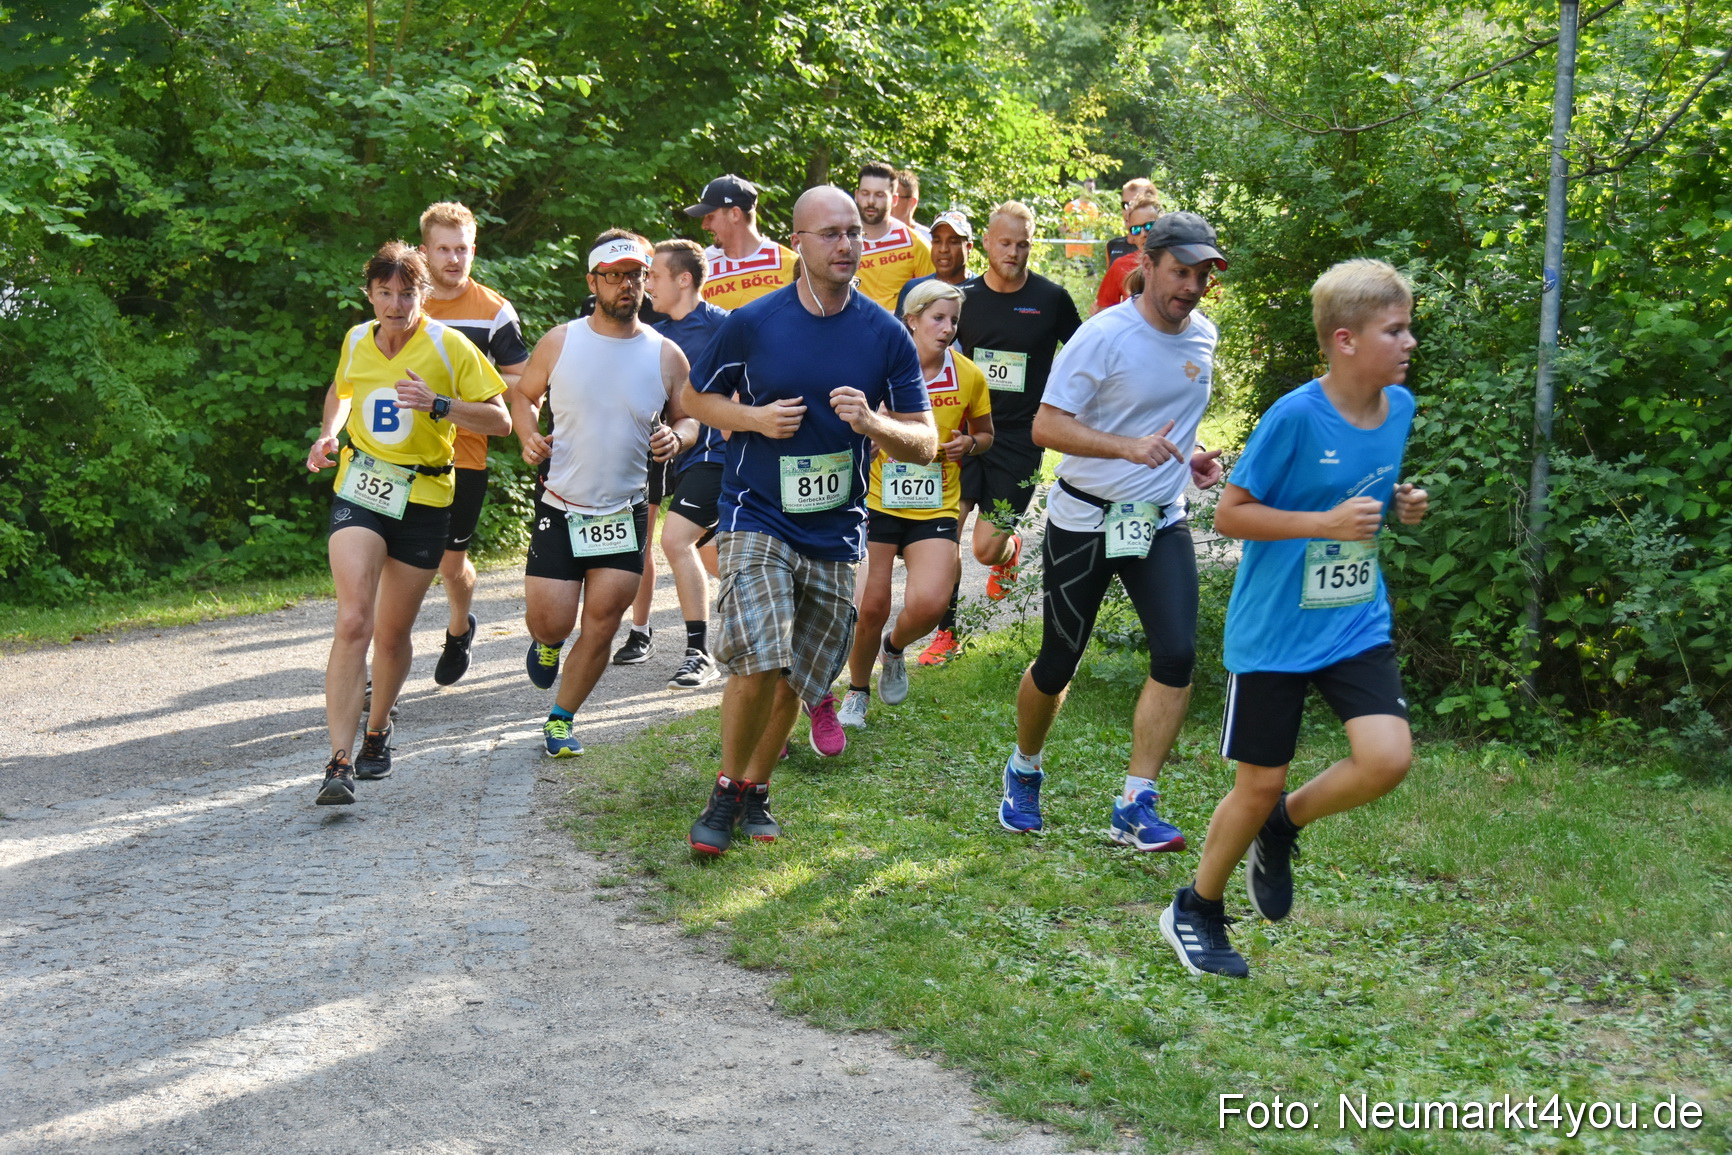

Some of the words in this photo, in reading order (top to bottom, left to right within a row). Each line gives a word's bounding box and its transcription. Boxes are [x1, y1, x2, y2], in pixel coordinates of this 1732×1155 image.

[858, 259, 875, 270] AX
[879, 252, 914, 265] BÖGL
[703, 281, 736, 299] MAX
[741, 274, 784, 289] BÖGL
[988, 365, 1007, 379] 50
[373, 399, 400, 432] B
[356, 473, 394, 501] 352
[798, 473, 839, 497] 810
[890, 479, 935, 495] 1670
[579, 523, 627, 543] 1855
[1315, 561, 1370, 589] 1536
